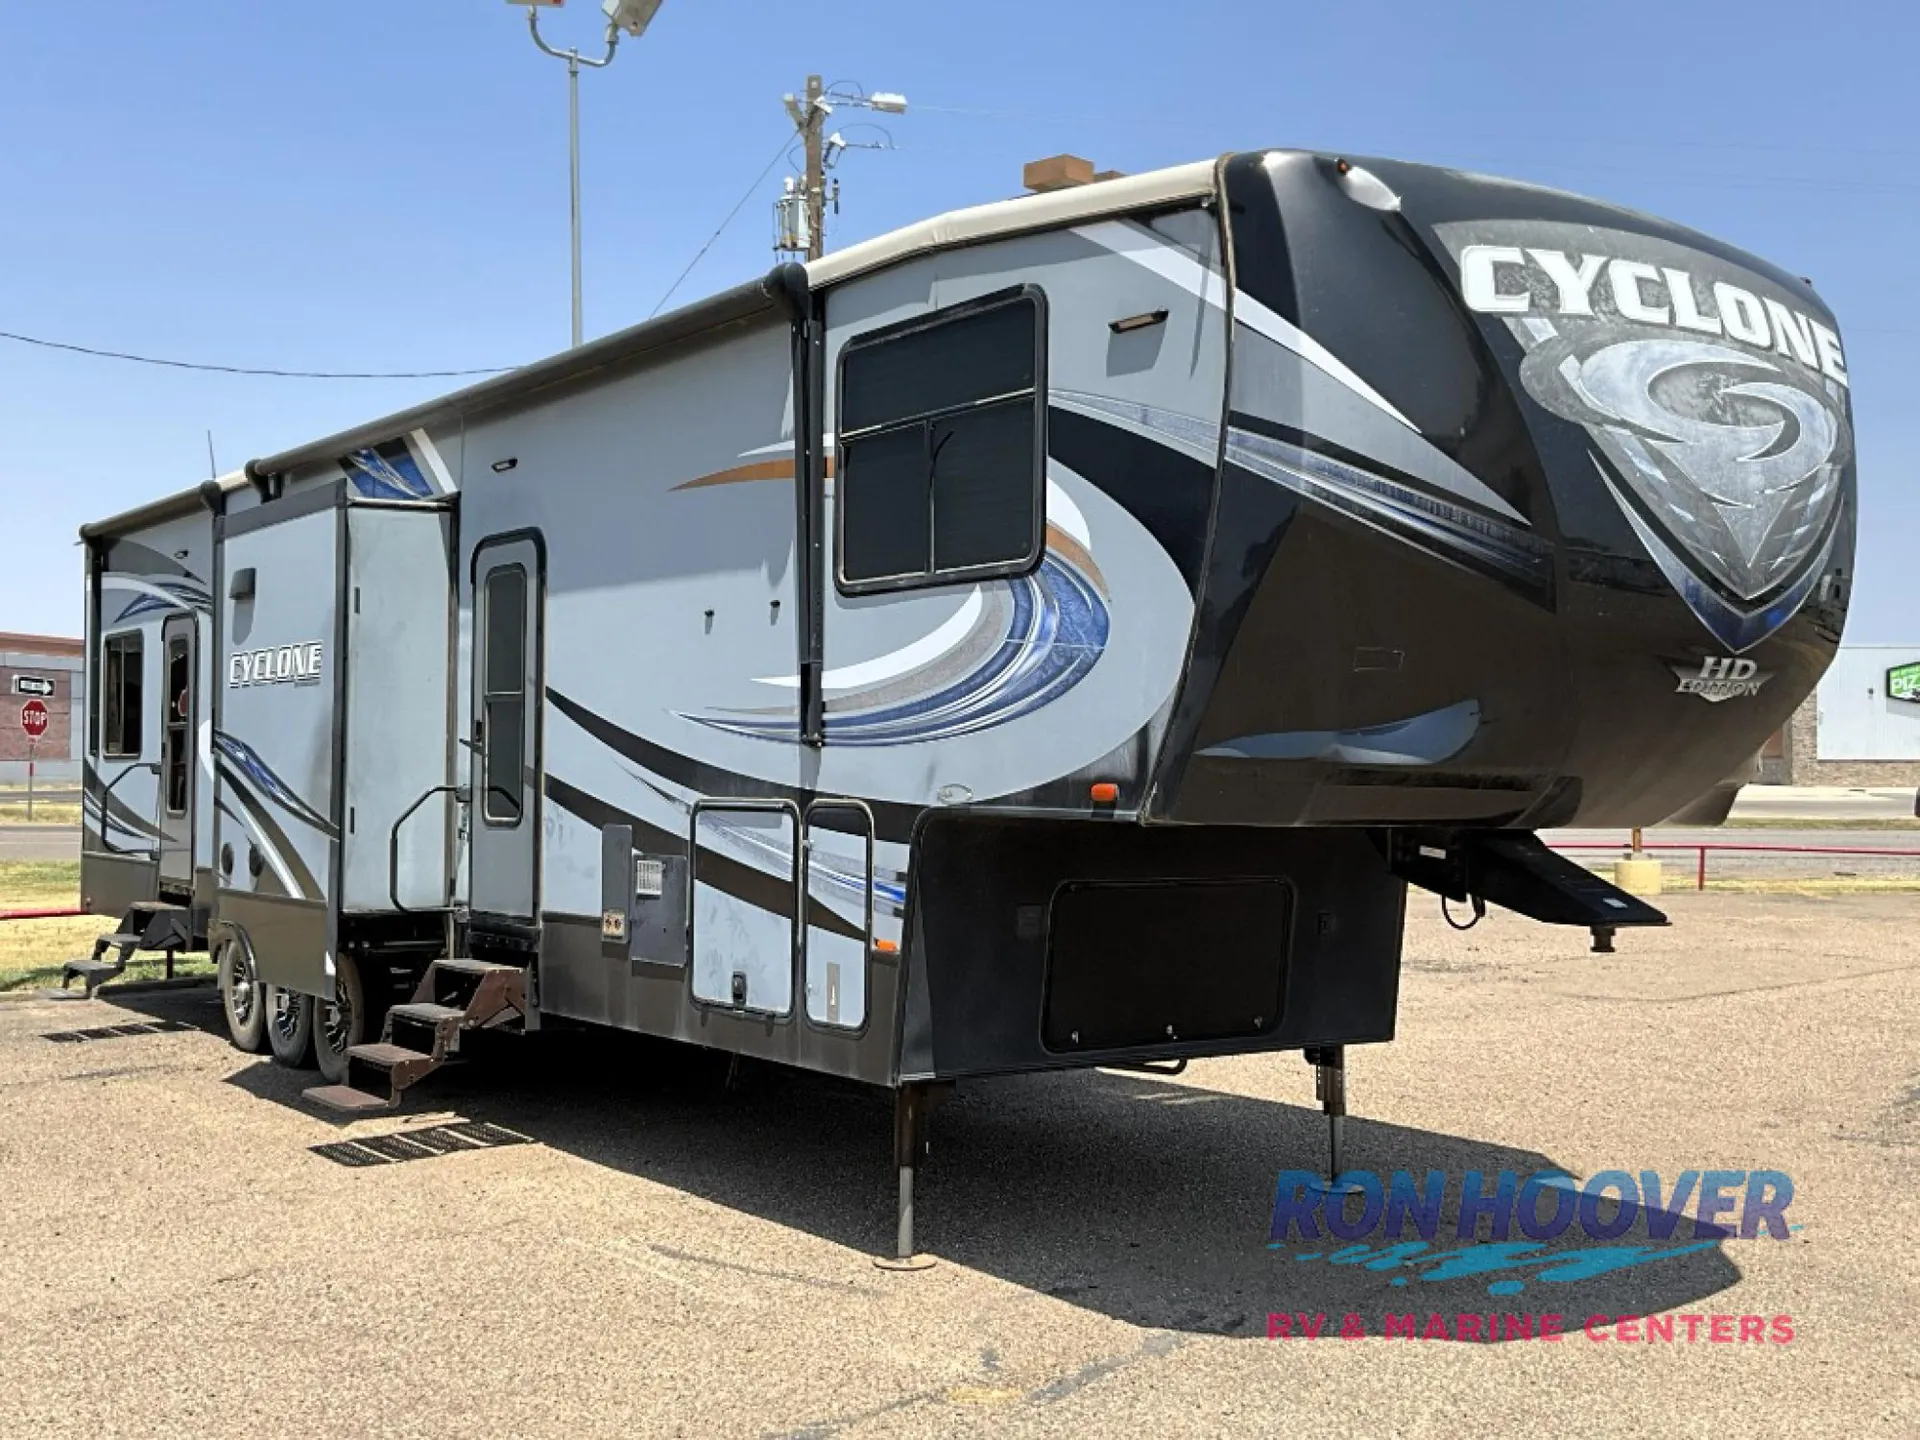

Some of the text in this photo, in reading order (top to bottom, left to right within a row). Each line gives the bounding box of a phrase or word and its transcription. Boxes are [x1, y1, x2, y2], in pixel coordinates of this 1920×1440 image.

[1460, 244, 1849, 387] CYCLONE
[229, 640, 323, 689] CYCLONE
[1699, 655, 1757, 680] HD
[1674, 678, 1761, 697] EDITION
[23, 710, 47, 727] STOP
